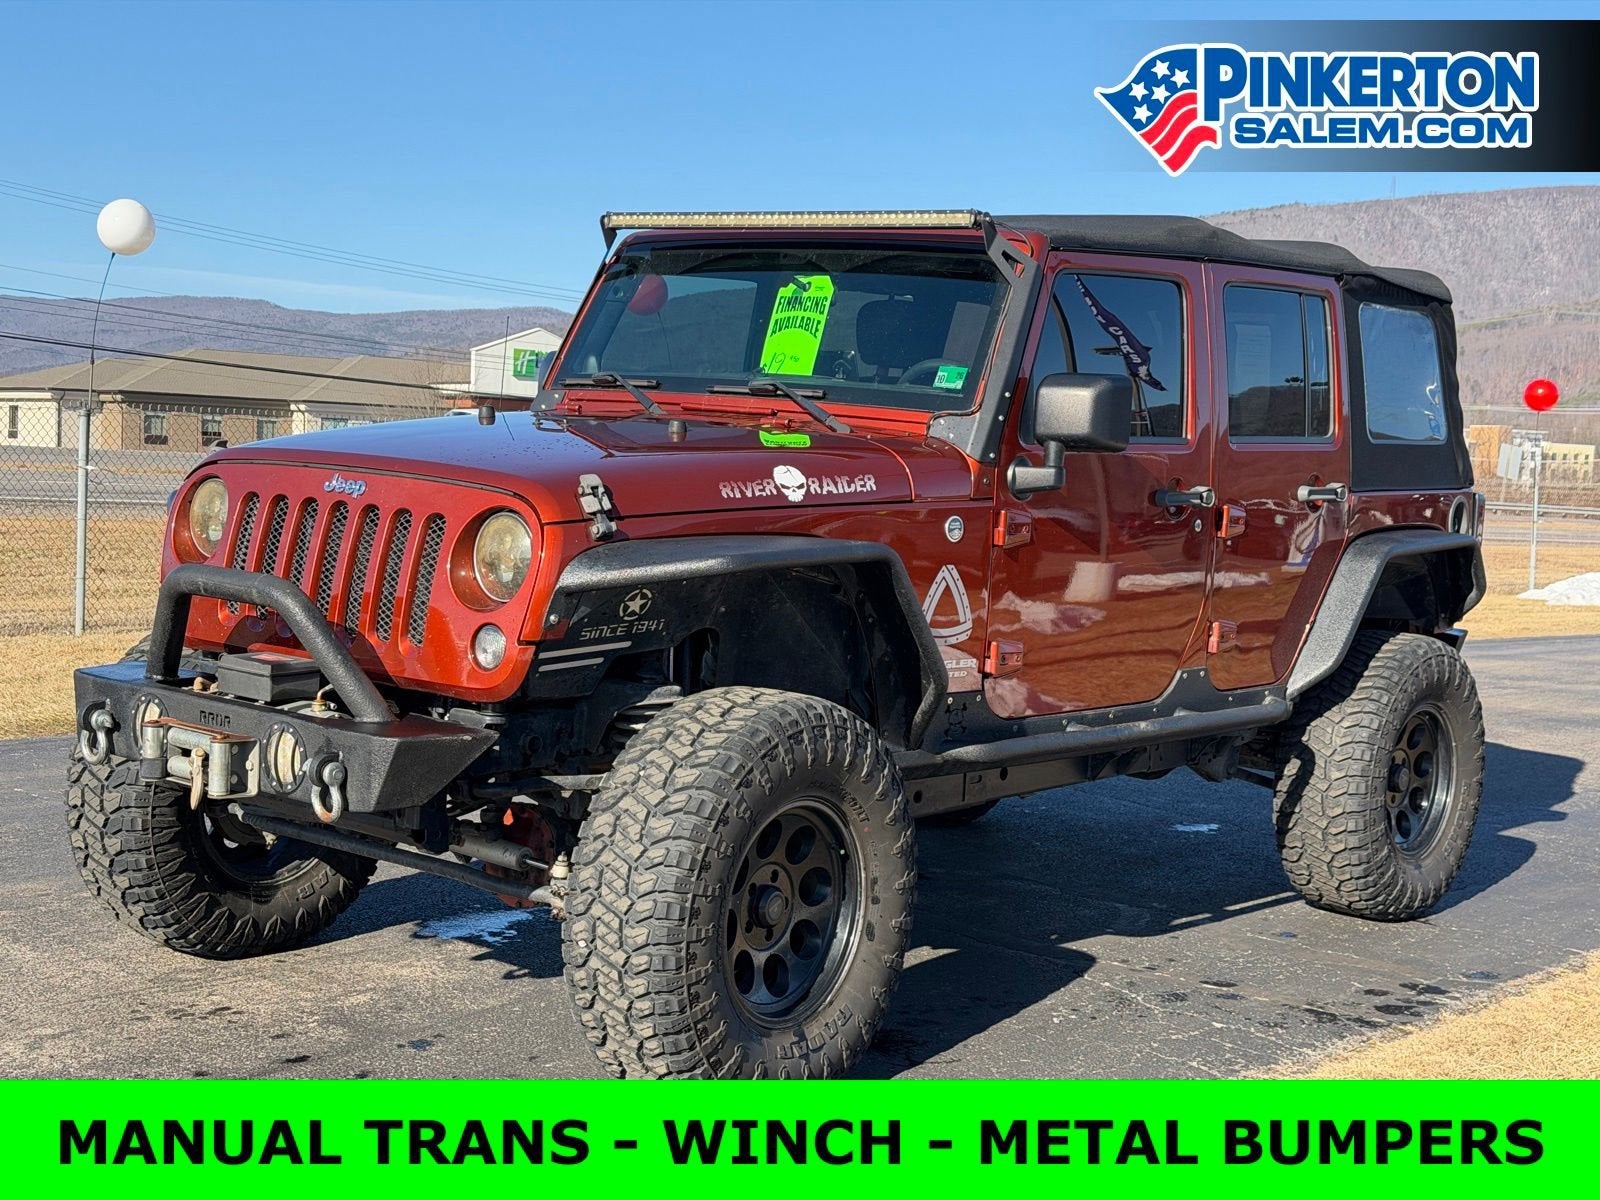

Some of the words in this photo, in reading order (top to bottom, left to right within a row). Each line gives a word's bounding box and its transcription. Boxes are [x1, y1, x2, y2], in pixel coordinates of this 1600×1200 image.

[775, 295, 829, 315] FINANCING
[769, 315, 822, 340] AVAILABLE
[324, 472, 368, 499] Jeep
[719, 478, 777, 498] RIVER
[807, 474, 877, 495] RAIDER
[579, 623, 627, 640] SINCE
[632, 619, 665, 634] 1941
